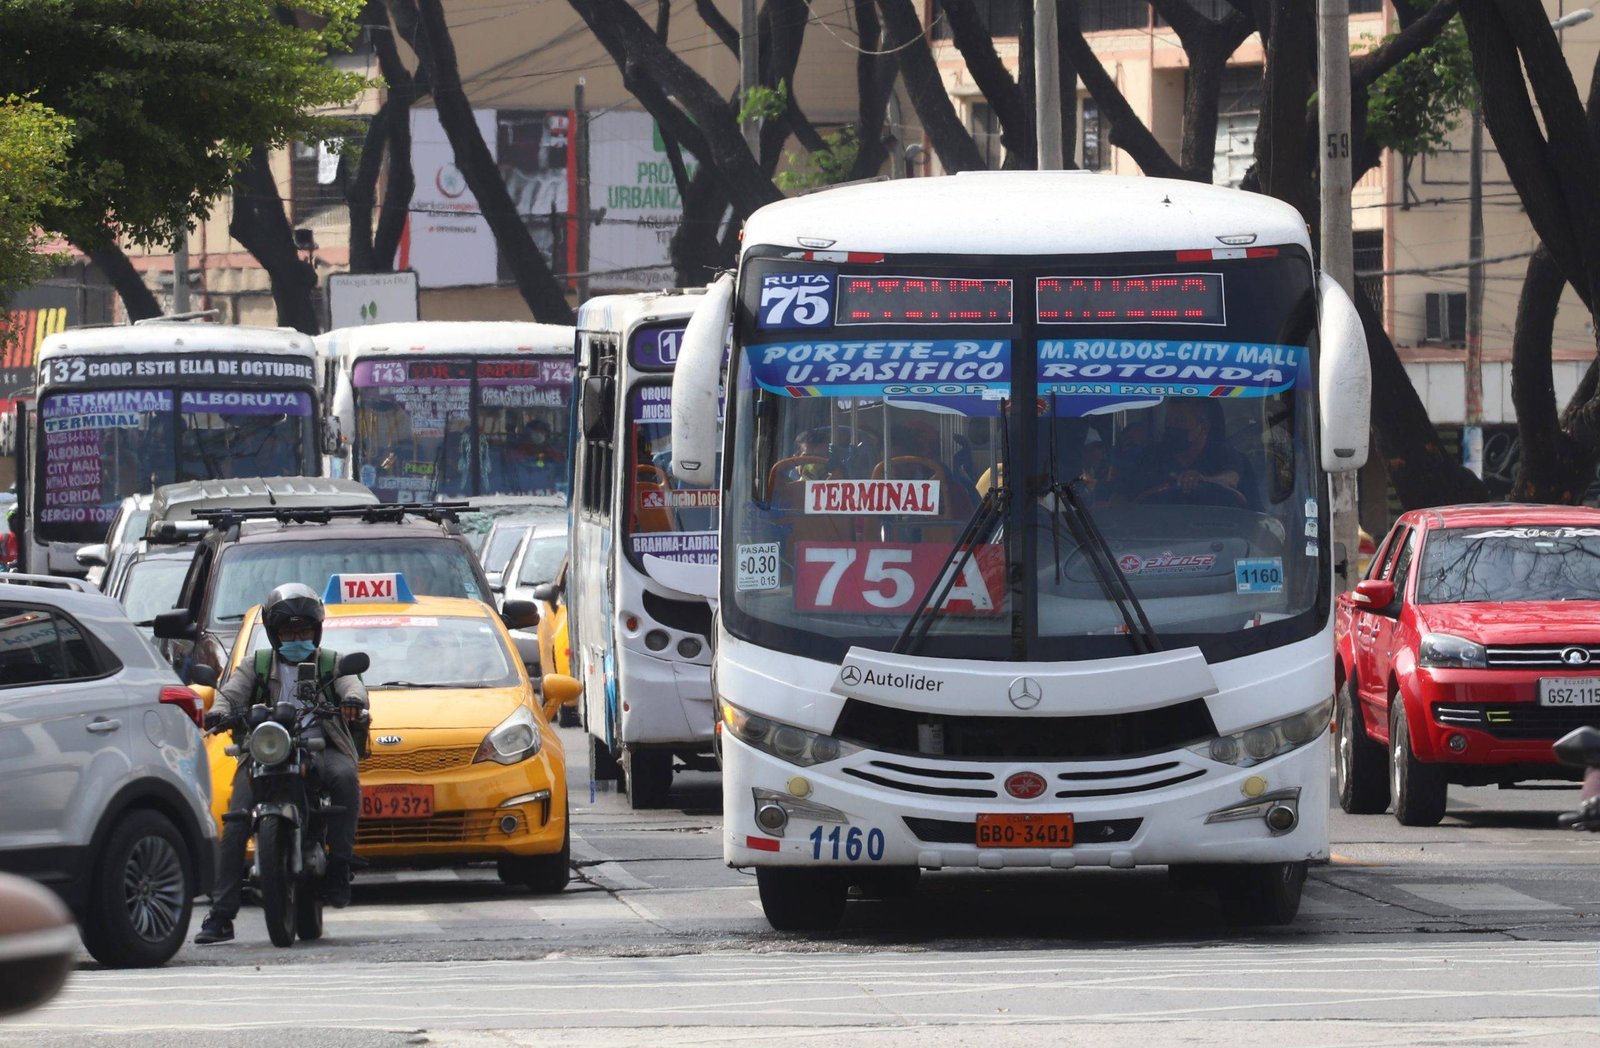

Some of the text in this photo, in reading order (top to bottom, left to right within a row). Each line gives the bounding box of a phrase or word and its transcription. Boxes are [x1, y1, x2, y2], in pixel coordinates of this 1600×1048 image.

[1327, 132, 1349, 159] 59
[764, 275, 830, 286] RUTA
[761, 284, 830, 325] 75
[762, 342, 1004, 365] PORTETE-PJ
[1235, 346, 1298, 367] MALL
[41, 360, 87, 384] 132
[218, 360, 238, 375] DE
[241, 361, 313, 379] OCTUBRE
[372, 368, 406, 383] 143
[542, 368, 574, 383] 143
[1042, 363, 1284, 382] ROTONDA
[882, 384, 990, 396] COOP
[1045, 384, 1199, 395] JUAN PABLO
[52, 391, 171, 407] TERMINAL
[181, 391, 298, 406] ALBORUTA
[90, 404, 109, 413] CITY
[112, 402, 136, 412] MALL
[46, 415, 138, 431] TERMINAL
[47, 445, 100, 460] ALBORADA
[47, 459, 101, 475] CITY MALL
[69, 472, 100, 487] ROLDOS
[46, 488, 100, 505] FLORIDA
[664, 490, 717, 507] Mucho Lote
[811, 482, 934, 513] TERMINAL
[41, 507, 86, 522] SERGIO
[741, 545, 777, 554] PASAJE
[740, 555, 777, 574] $0.30
[1241, 568, 1280, 584] 1160
[344, 580, 392, 598] TAXI
[864, 669, 944, 692] Autolider
[379, 735, 401, 744] KIA
[980, 824, 1070, 843] GBO-3401
[809, 825, 885, 861] 1160
